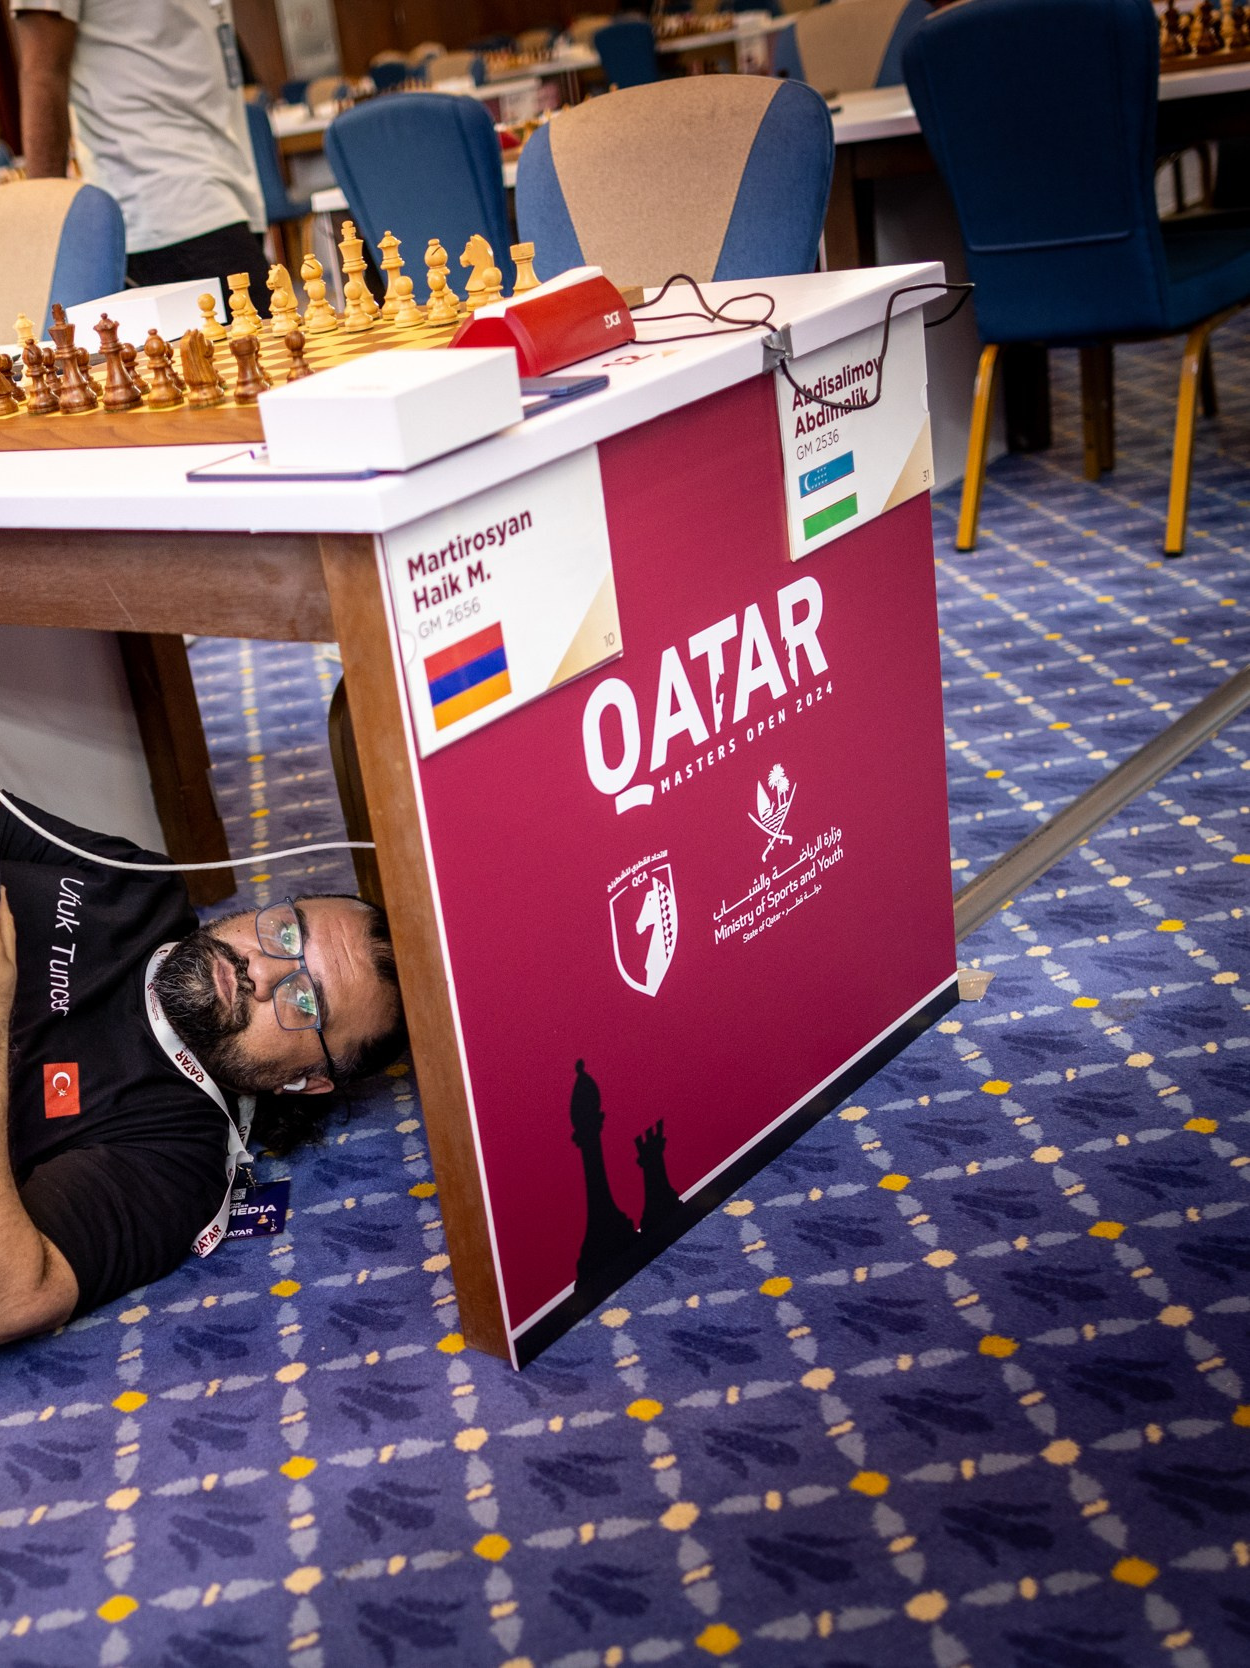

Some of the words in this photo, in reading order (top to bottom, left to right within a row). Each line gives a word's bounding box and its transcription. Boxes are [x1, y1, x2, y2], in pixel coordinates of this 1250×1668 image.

[796, 440, 813, 461] GM
[816, 428, 840, 452] 2536
[922, 468, 930, 483] 31
[407, 509, 532, 582] Martirosyan
[413, 572, 462, 613] Haik
[467, 560, 491, 588] M.
[418, 614, 442, 640] GM
[446, 596, 481, 627] 2656
[603, 631, 616, 648] 10
[582, 576, 829, 815] QATAR
[660, 738, 737, 794] MASTERS
[746, 708, 787, 742] OPEN
[796, 681, 833, 713] 2024
[631, 870, 649, 887] QCA
[714, 911, 755, 944] Ministry
[755, 896, 766, 916] of
[767, 880, 799, 908] Sports
[799, 862, 816, 886] and
[817, 844, 844, 872] Youth
[742, 928, 759, 943] State
[758, 921, 765, 932] of
[765, 912, 781, 928] Qatar
[175, 1050, 205, 1083] QATAR
